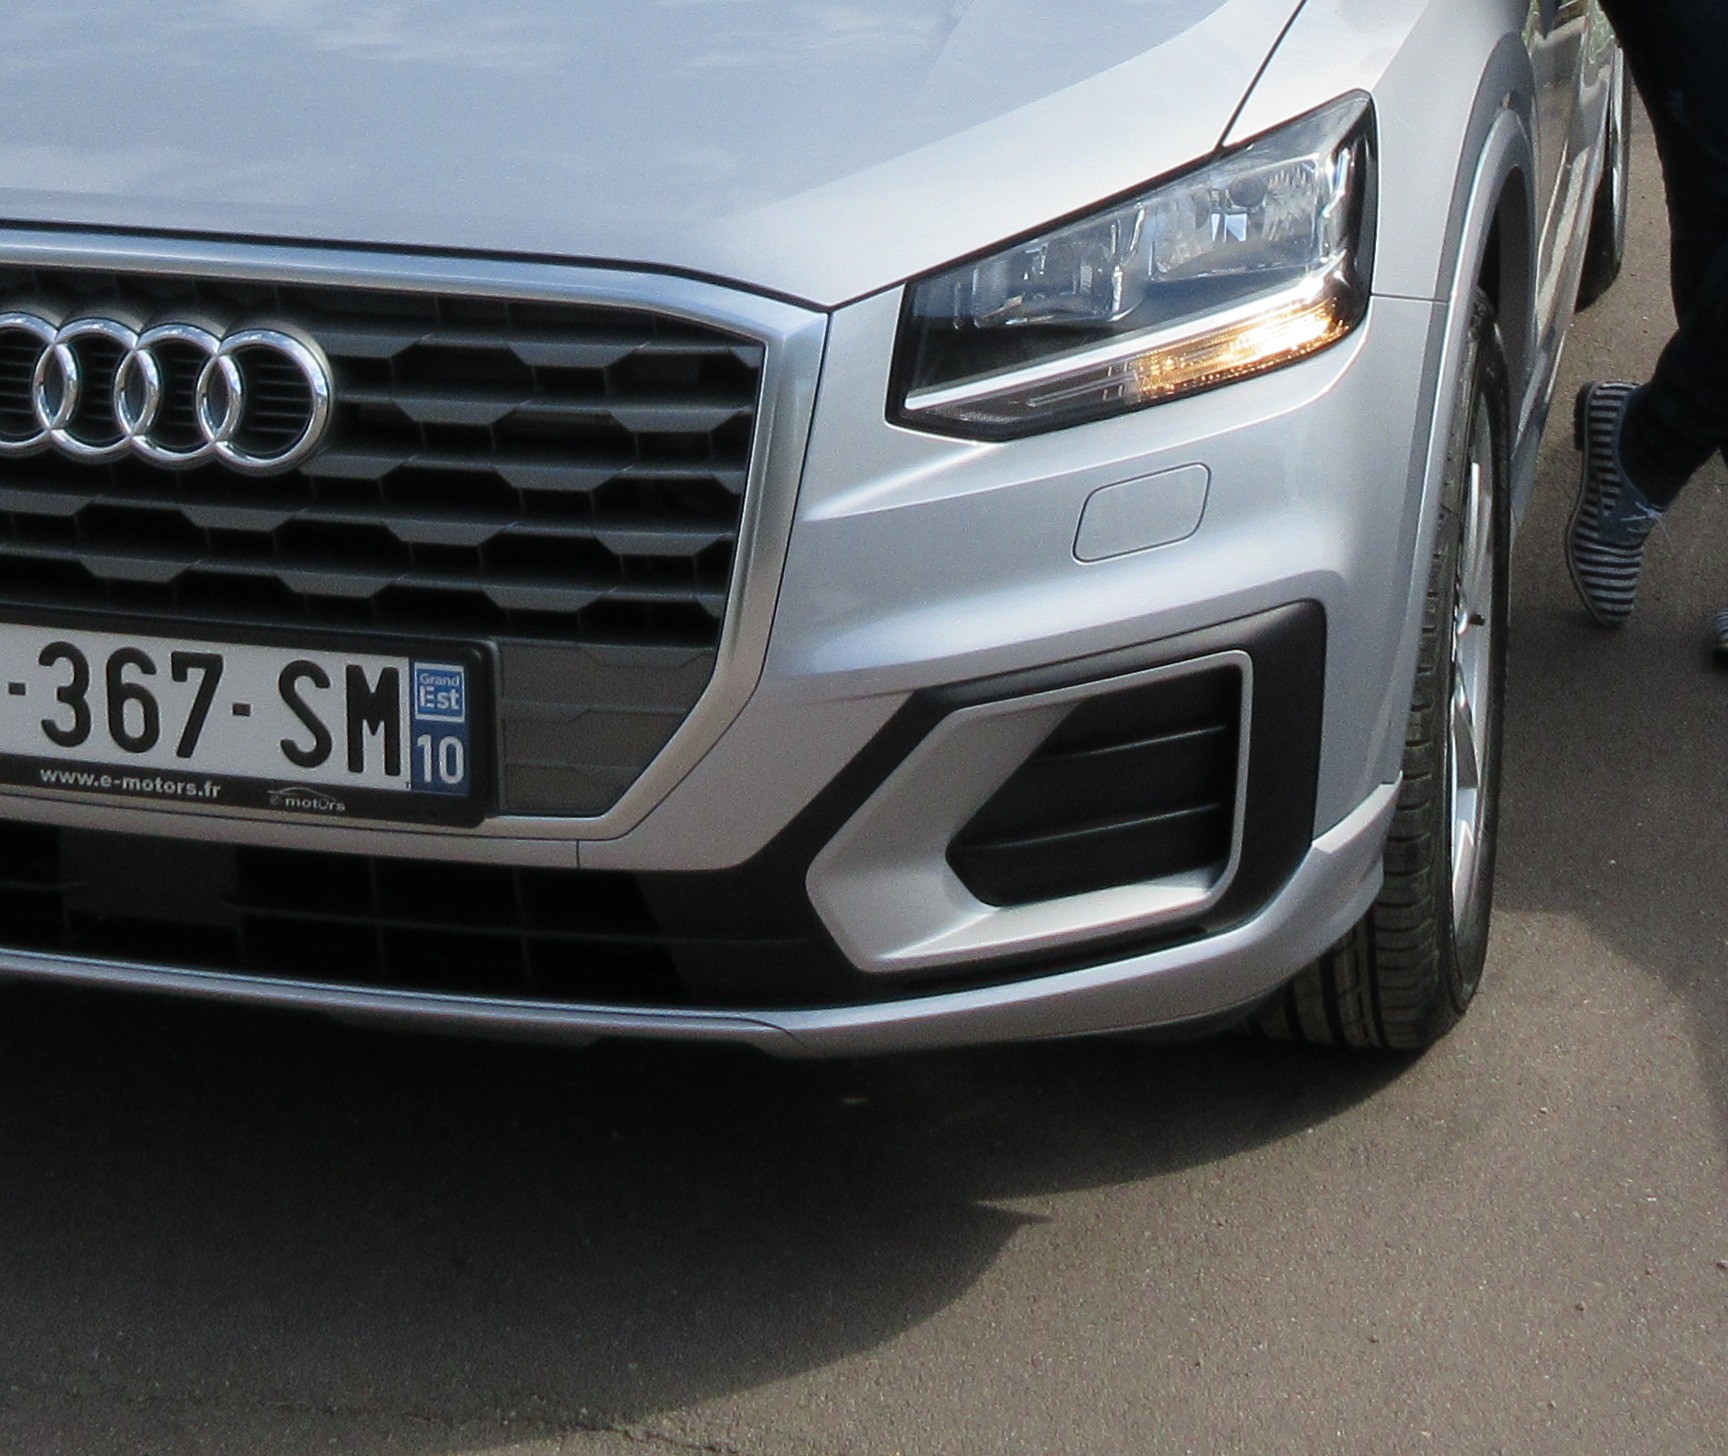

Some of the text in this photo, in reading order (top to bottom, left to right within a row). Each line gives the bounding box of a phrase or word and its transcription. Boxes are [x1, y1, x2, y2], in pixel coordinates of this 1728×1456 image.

[419, 673, 460, 686] Grand
[419, 686, 460, 709] Est
[418, 735, 464, 784] 10
[39, 766, 222, 800] www.e-motors.fr
